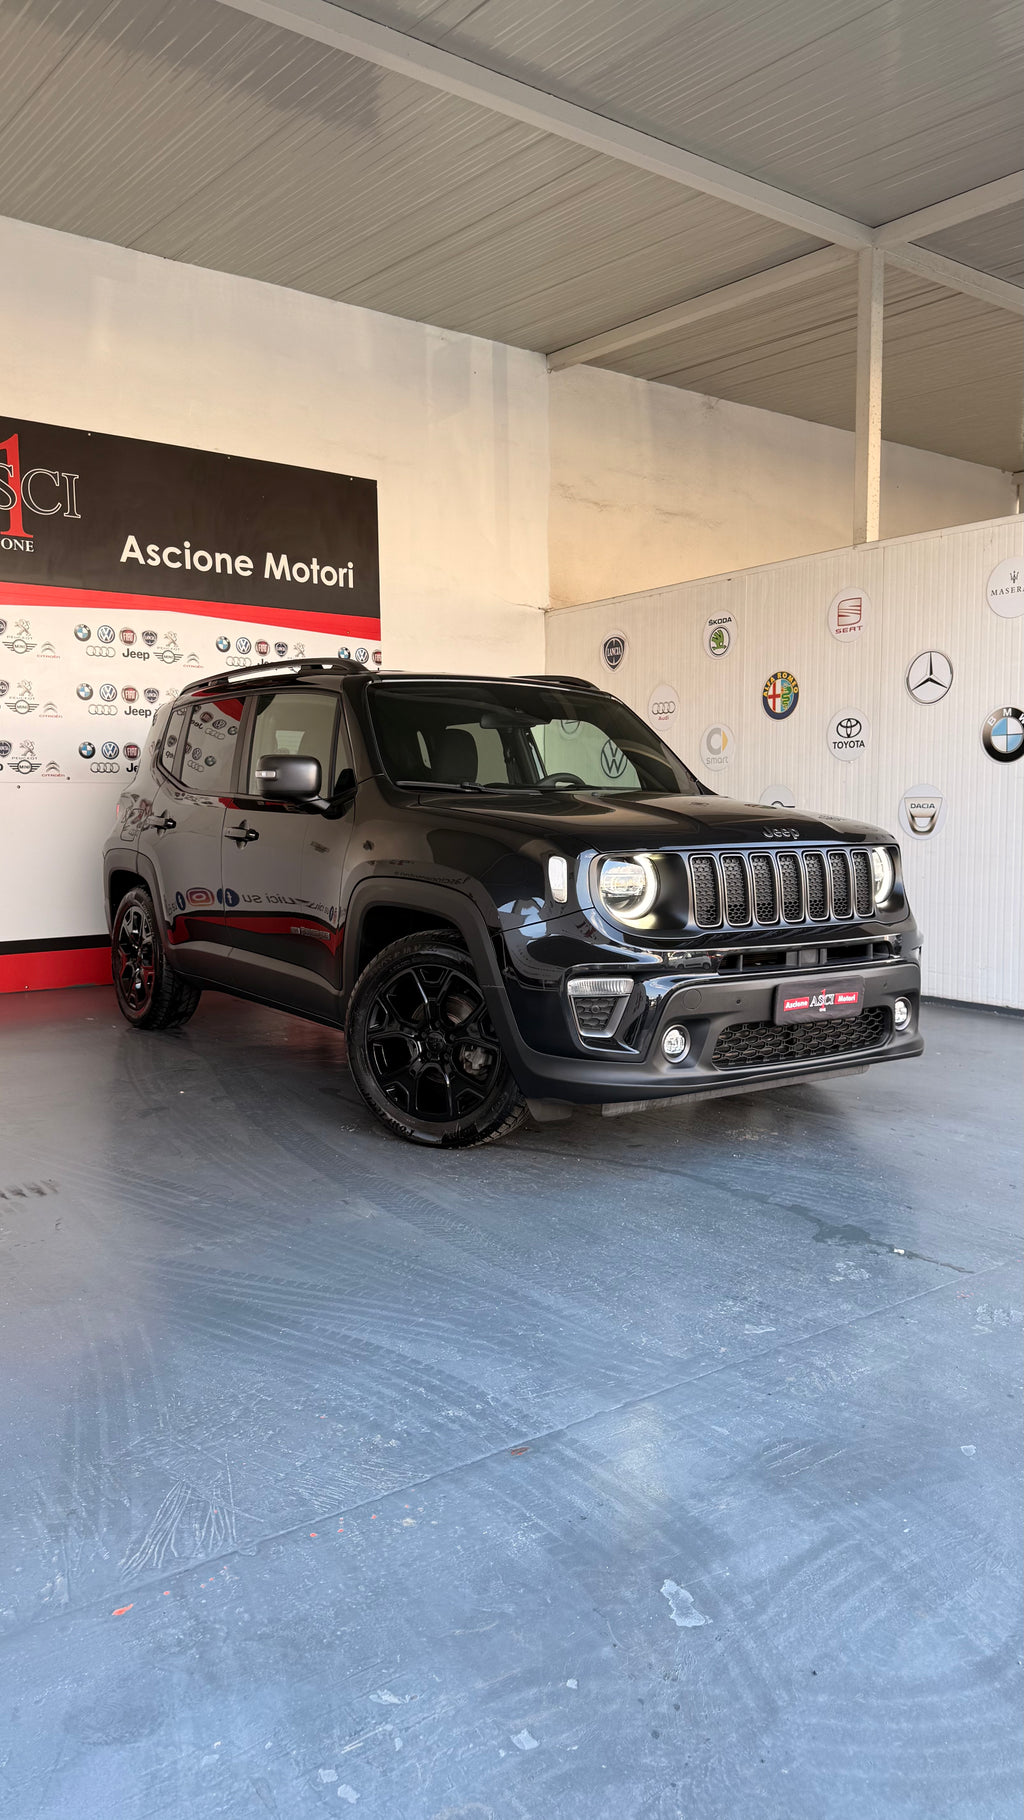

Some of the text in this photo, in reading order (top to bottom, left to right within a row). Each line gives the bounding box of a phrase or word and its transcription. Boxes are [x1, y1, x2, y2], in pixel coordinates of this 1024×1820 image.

[119, 534, 354, 589] Ascione Motori
[835, 625, 864, 635] SEAT
[122, 648, 150, 662] Jeep
[762, 671, 799, 698] ALFA ROMEO
[124, 705, 152, 719] Jeep
[832, 740, 866, 750] TOYOTA
[706, 756, 729, 765] smart
[762, 826, 800, 840] Jeep
[785, 1000, 808, 1010] Ascione
[837, 994, 856, 1003] Motori
